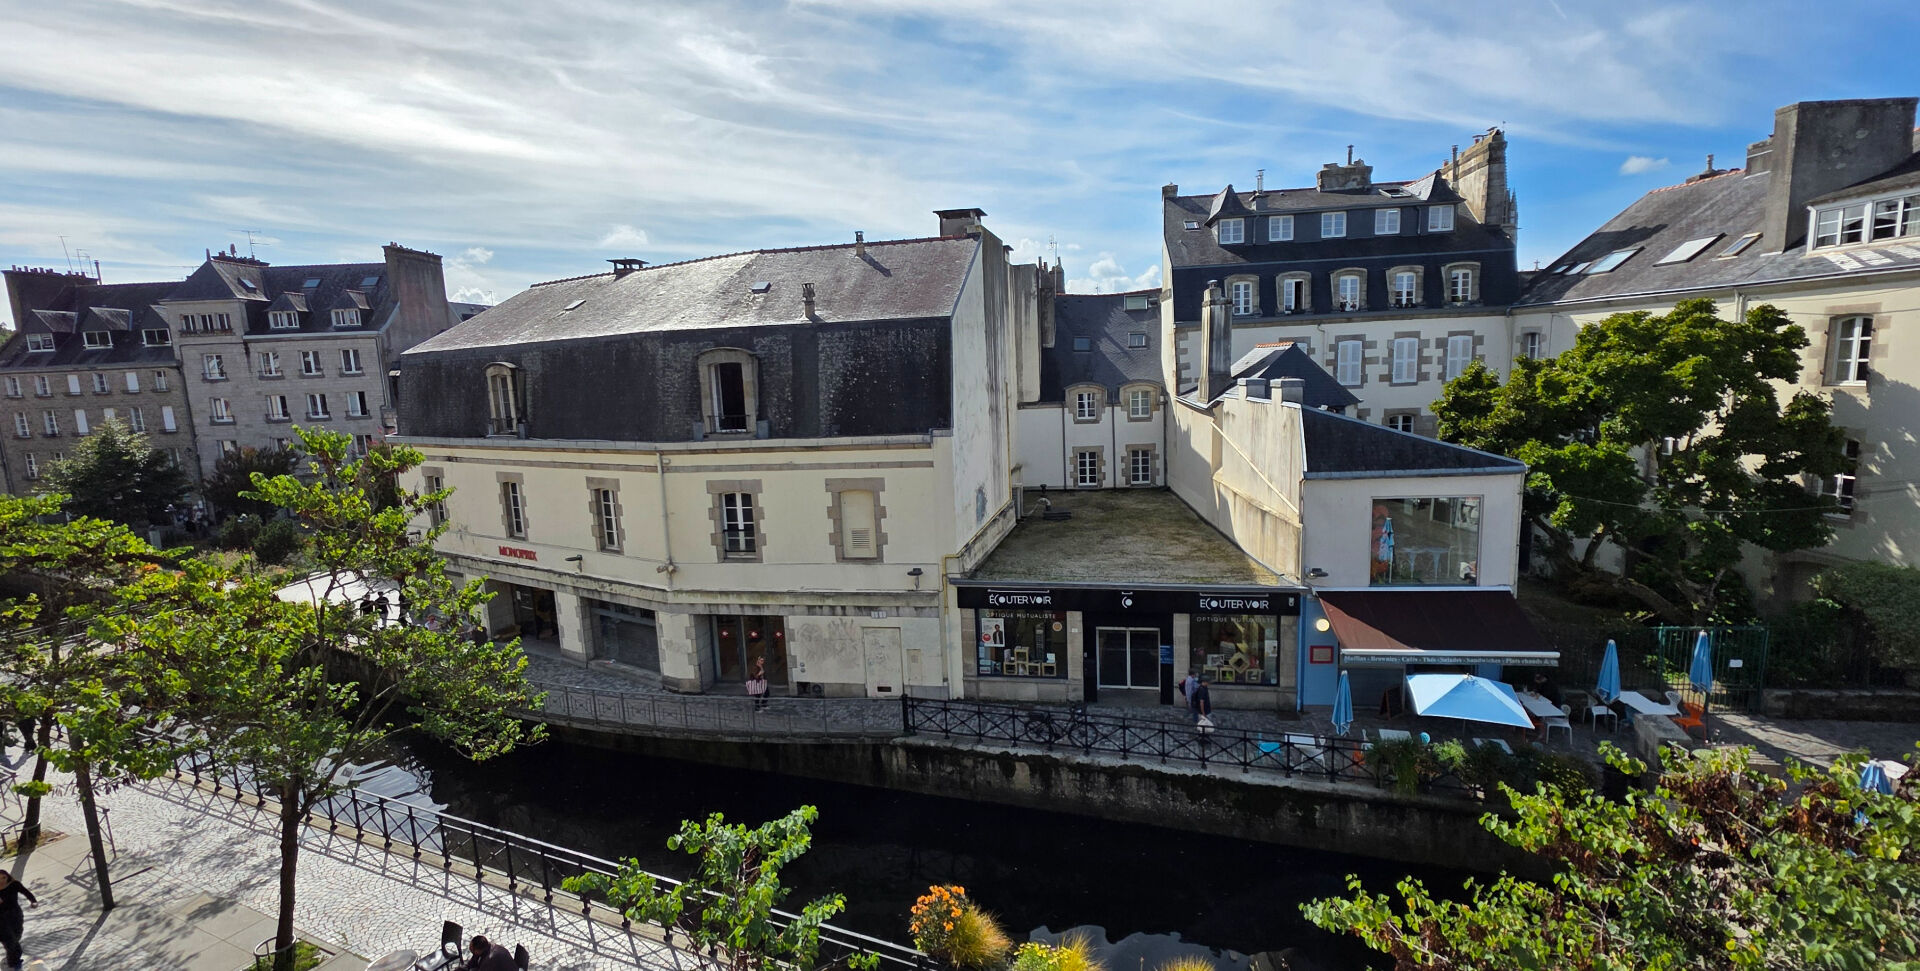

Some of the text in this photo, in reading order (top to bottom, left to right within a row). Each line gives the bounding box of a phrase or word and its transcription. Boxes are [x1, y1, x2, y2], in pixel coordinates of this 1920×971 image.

[498, 546, 538, 561] MONOPRIX
[1029, 596, 1052, 605] VOIR
[1244, 599, 1269, 609] VOIR
